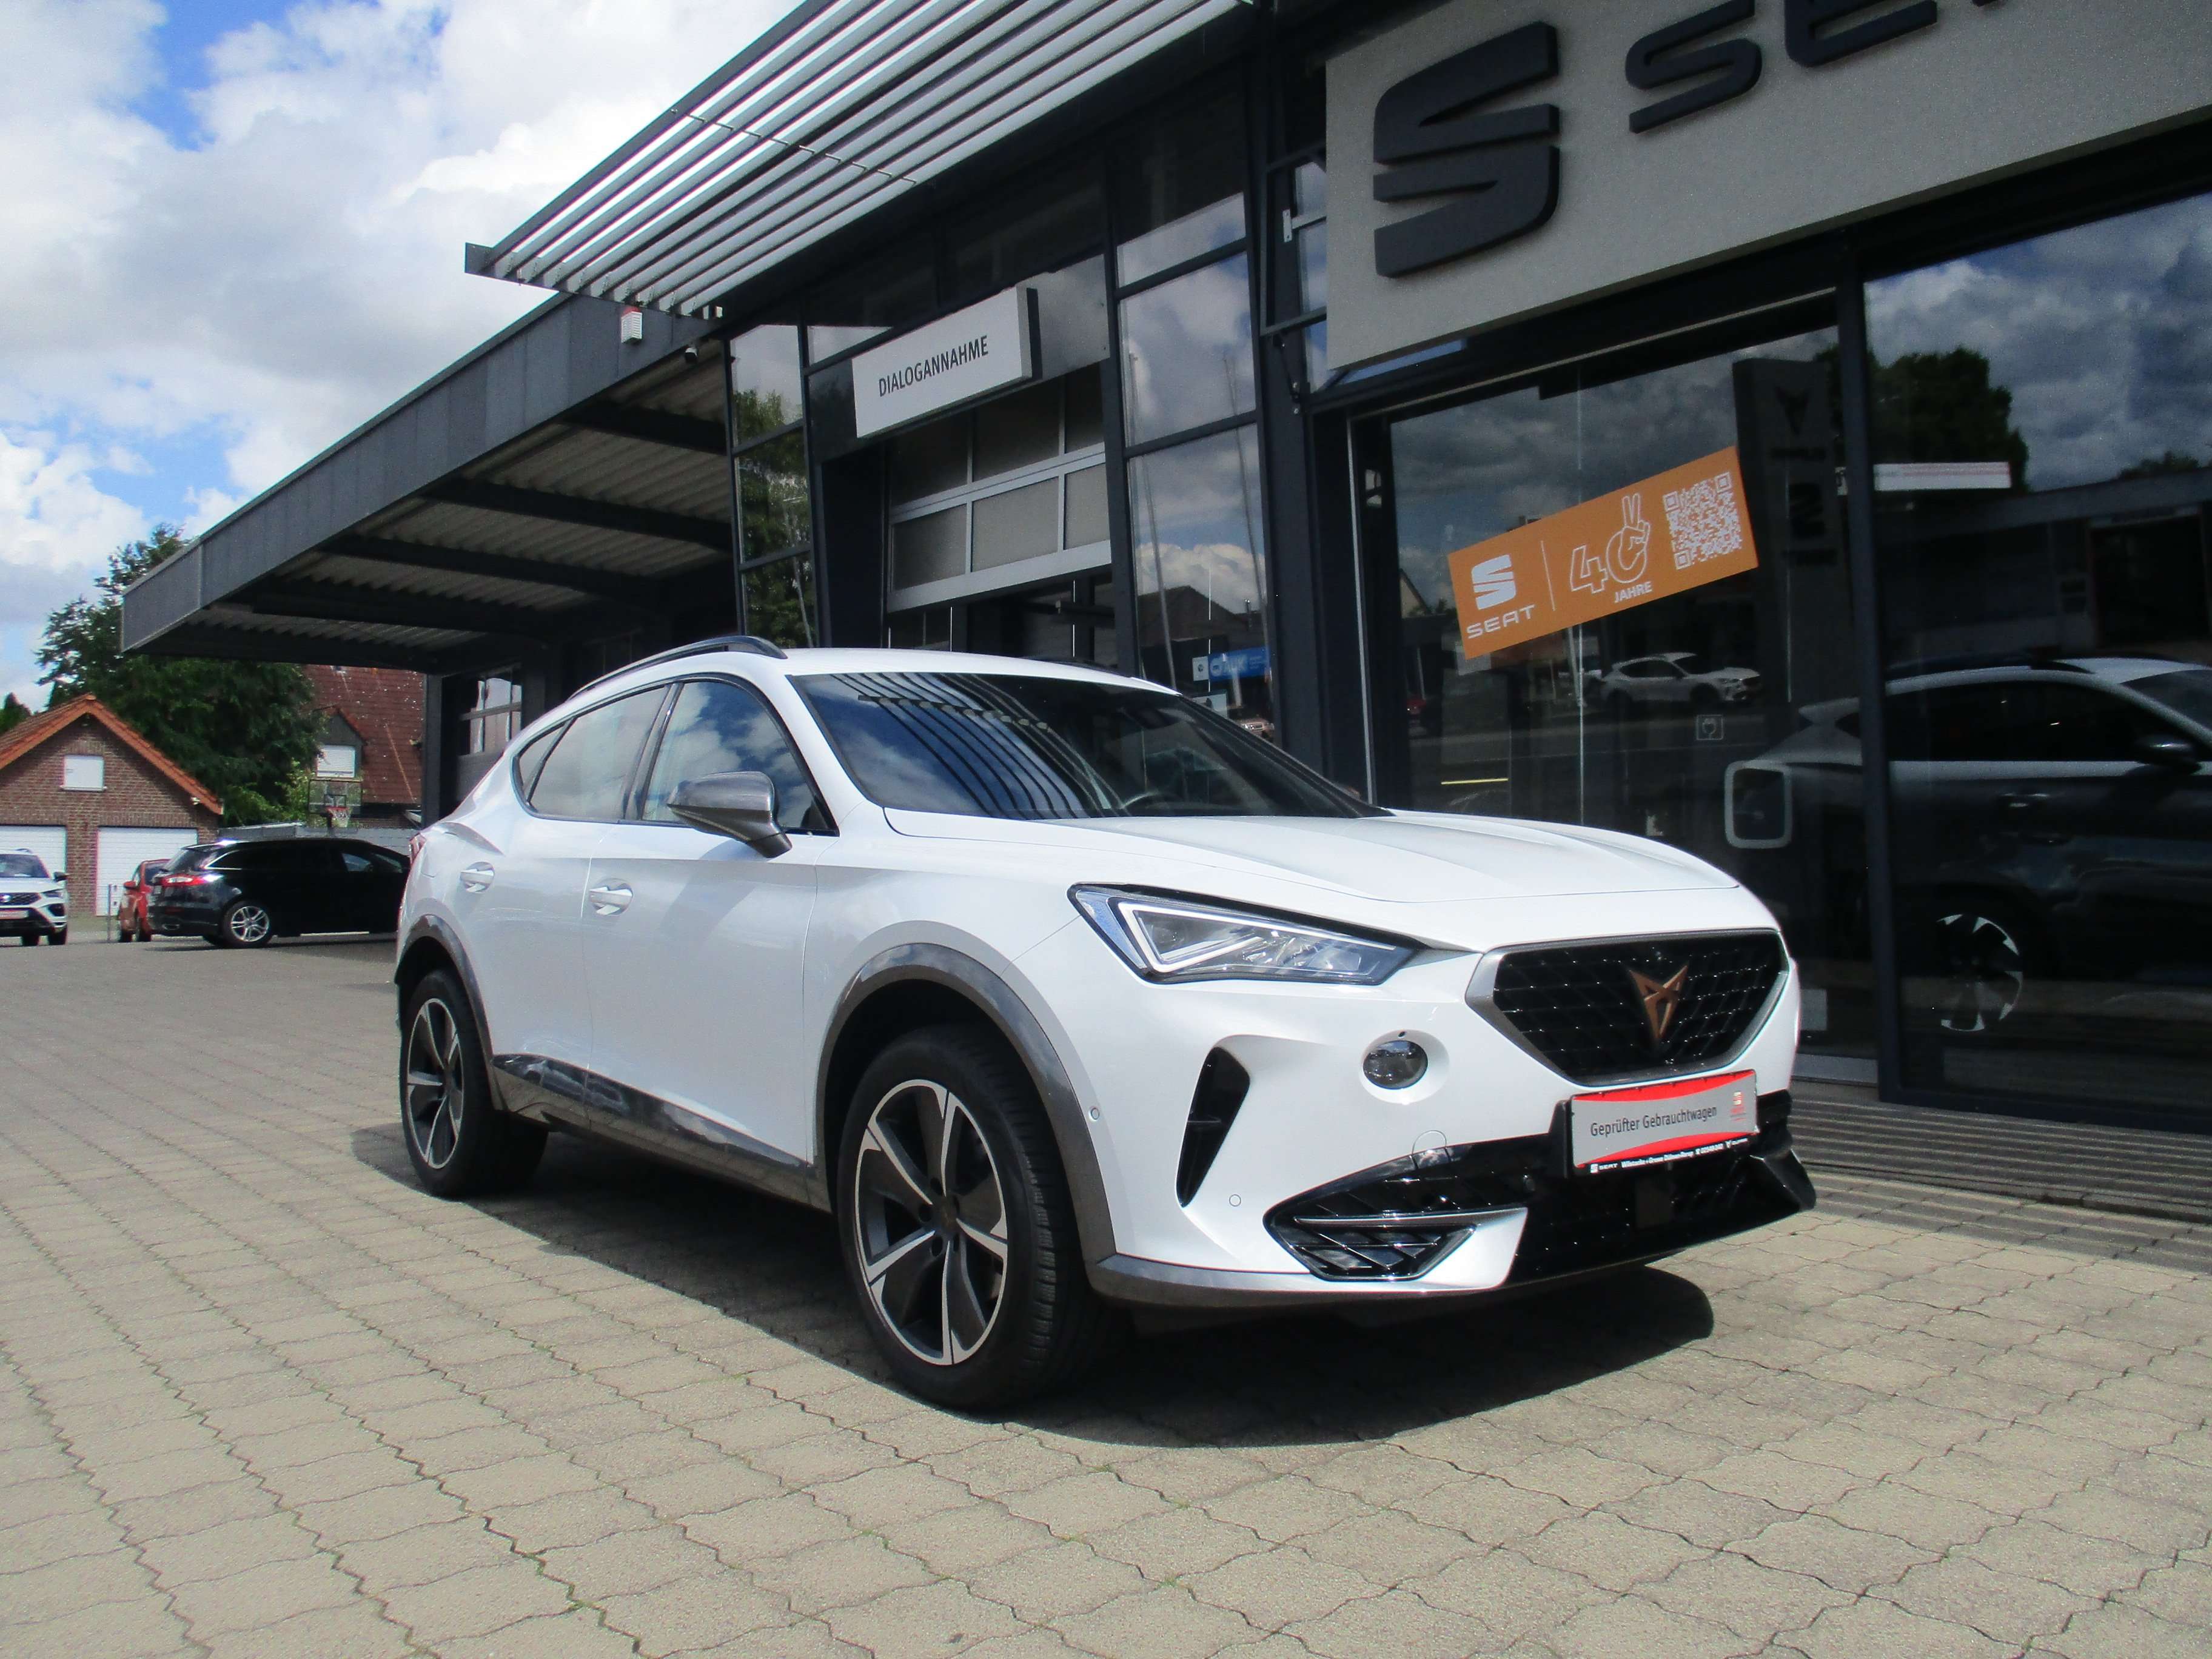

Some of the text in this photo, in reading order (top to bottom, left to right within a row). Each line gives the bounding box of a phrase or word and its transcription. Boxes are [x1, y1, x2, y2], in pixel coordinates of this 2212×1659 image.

[879, 335, 988, 397] DIALOGANNAHME
[1614, 581, 1652, 603] JAHRE
[1466, 604, 1535, 640] SEAT
[1590, 1117, 1640, 1138] Geprüfter
[1642, 1105, 1718, 1128] Gebrauchtwagen
